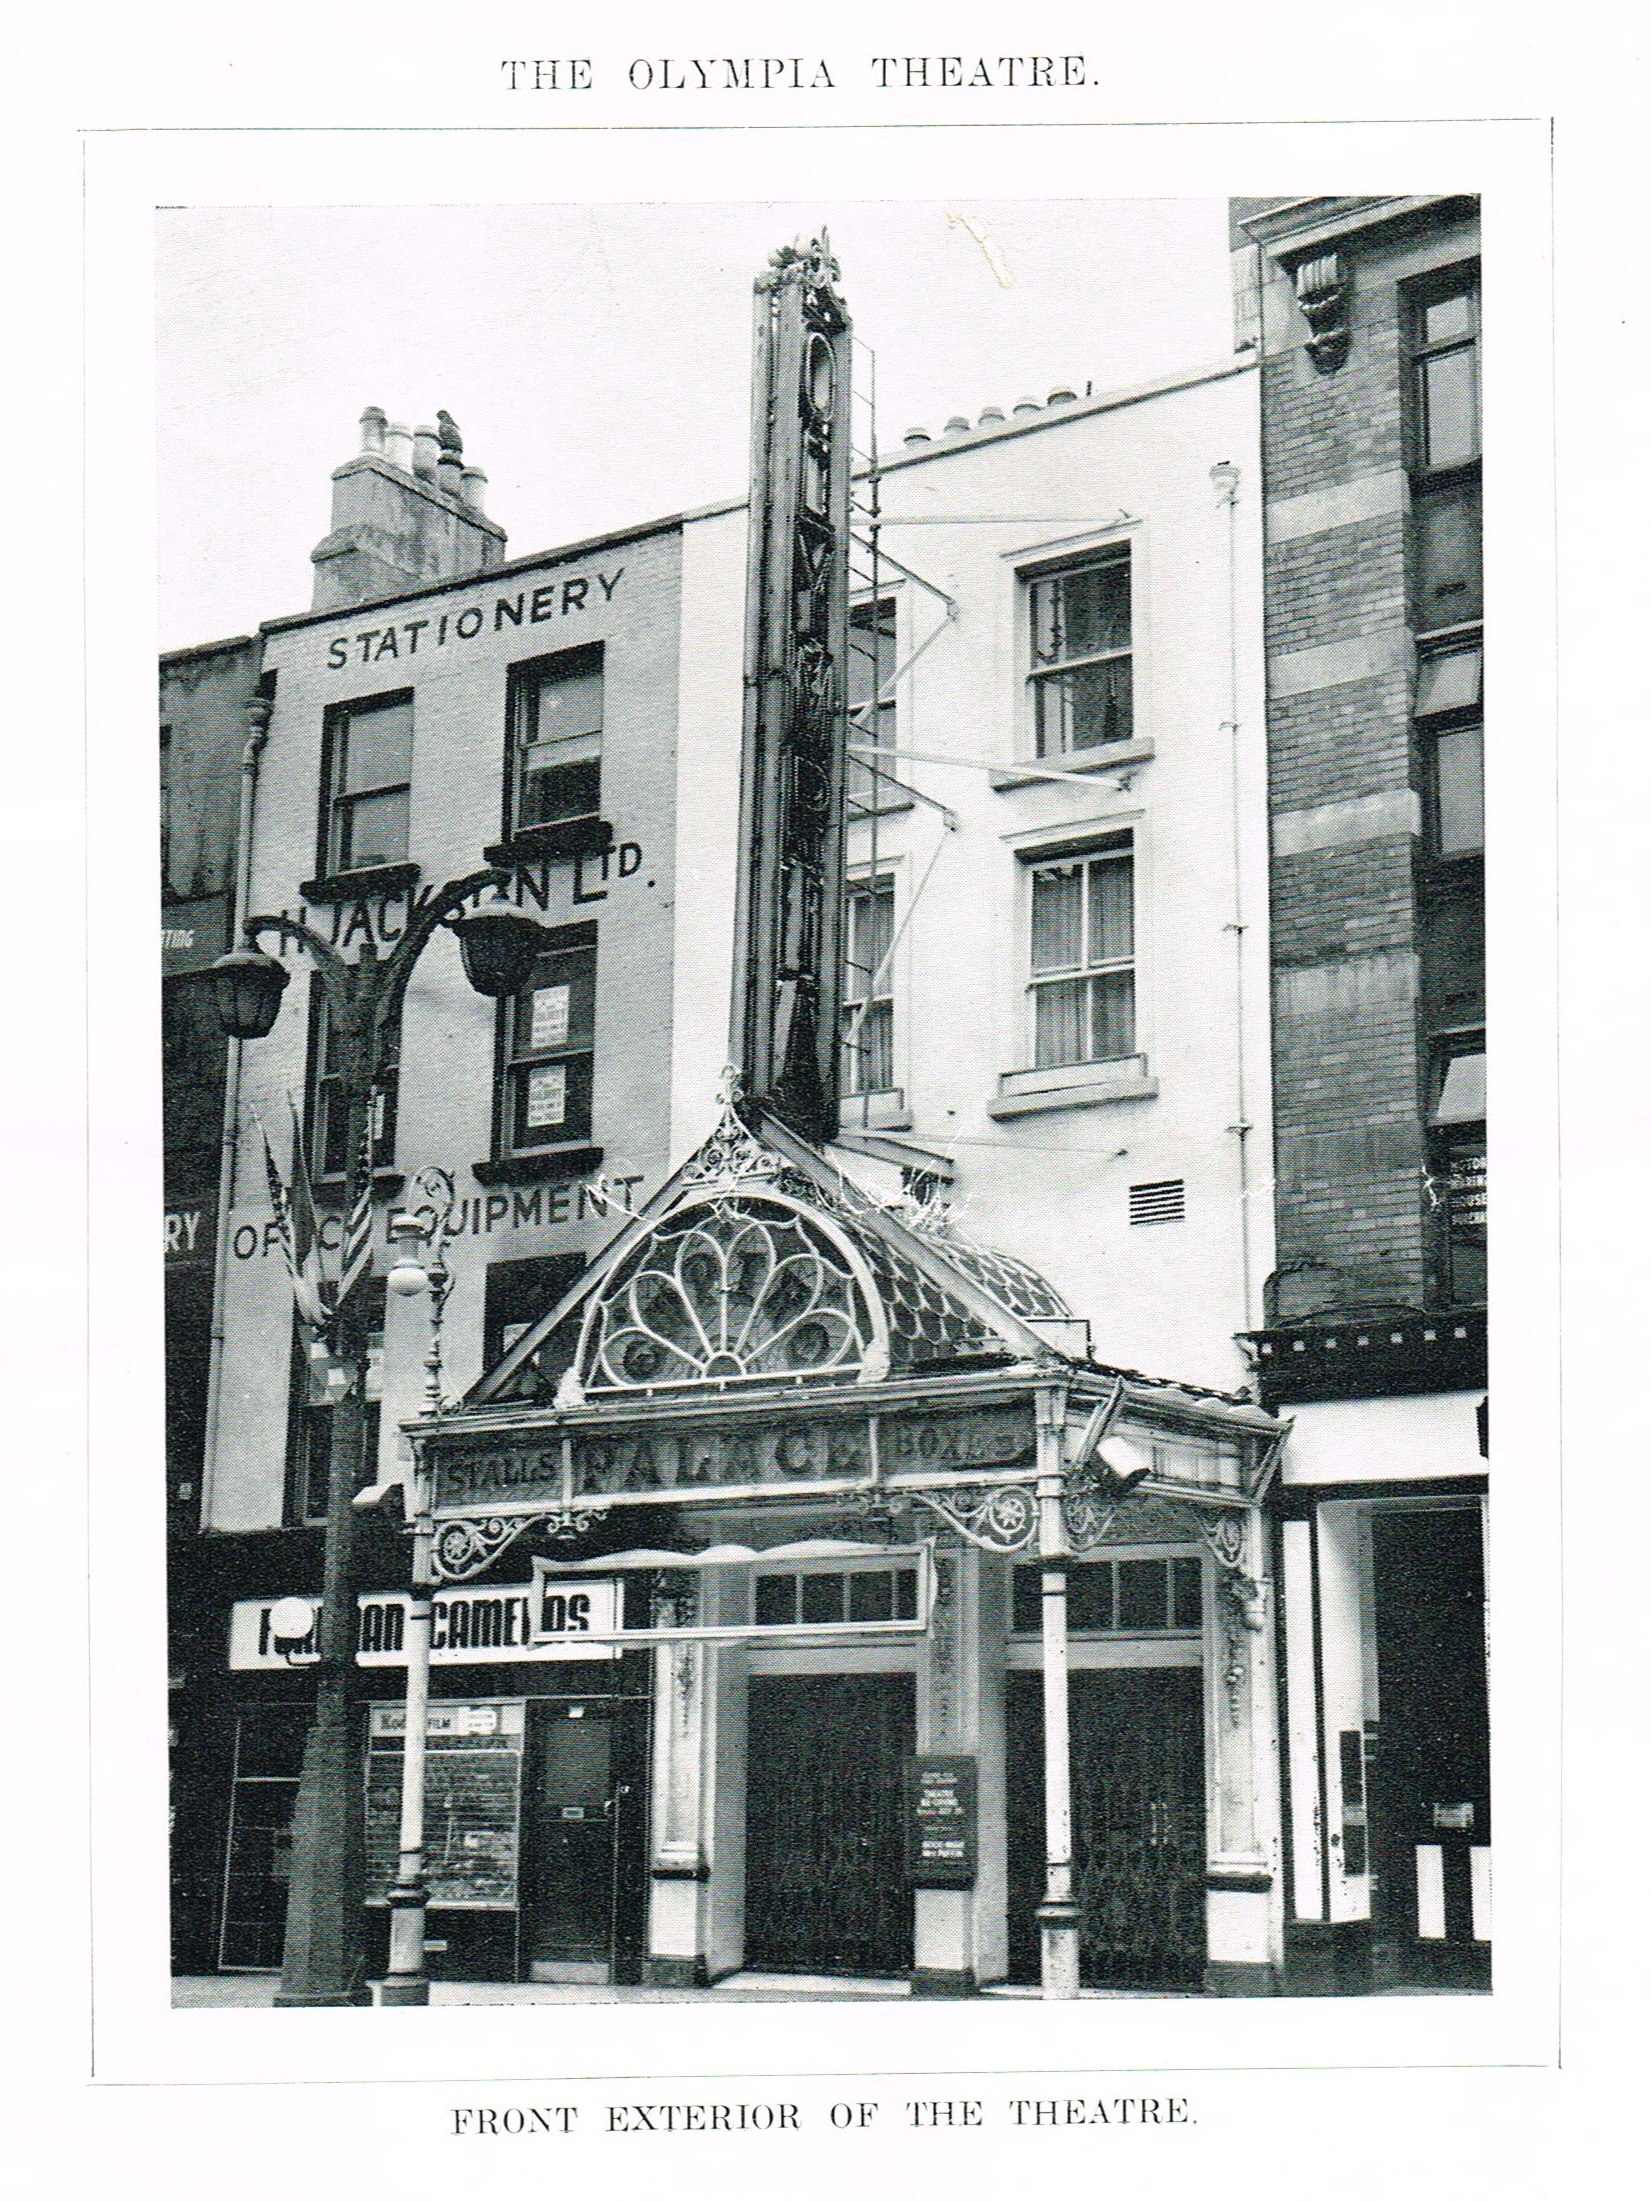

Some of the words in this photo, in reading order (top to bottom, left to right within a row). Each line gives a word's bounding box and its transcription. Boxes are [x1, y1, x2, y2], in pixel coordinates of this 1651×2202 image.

[327, 567, 625, 669] STATIONERY
[328, 864, 551, 947] JACKN
[385, 1174, 645, 1247] EQUIPMENT
[446, 1450, 557, 1490] STALLS
[581, 1427, 862, 1492] PALACE
